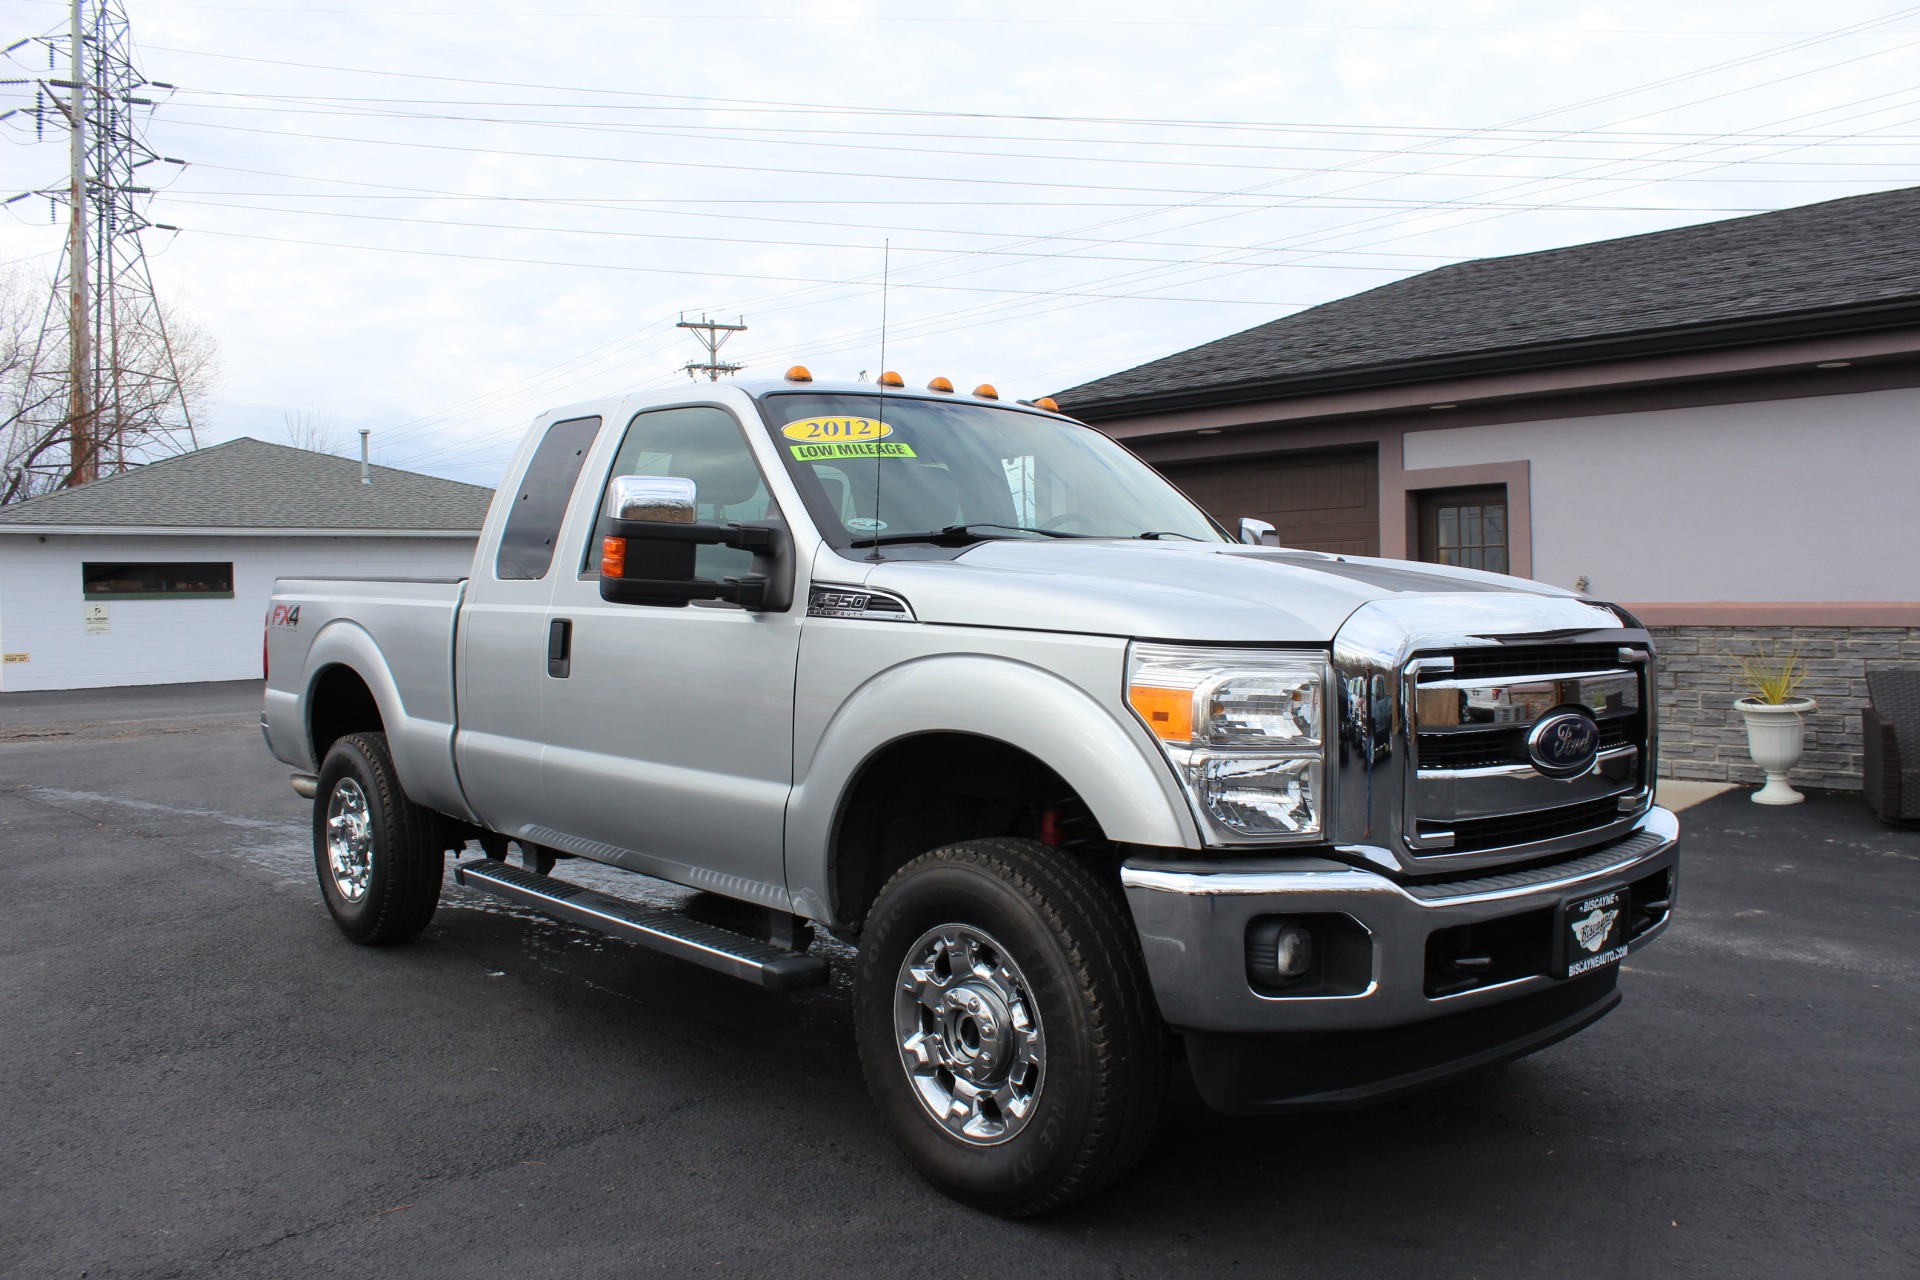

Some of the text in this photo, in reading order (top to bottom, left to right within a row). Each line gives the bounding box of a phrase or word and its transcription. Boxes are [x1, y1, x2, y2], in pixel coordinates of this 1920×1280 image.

[805, 420, 872, 438] 2012
[798, 443, 907, 458] LOW MILEAGE
[271, 604, 301, 627] FX4
[1554, 723, 1590, 757] Ford
[1583, 893, 1616, 912] BISCAYNE
[1568, 945, 1628, 977] BISCAYNEAUTO.COM
